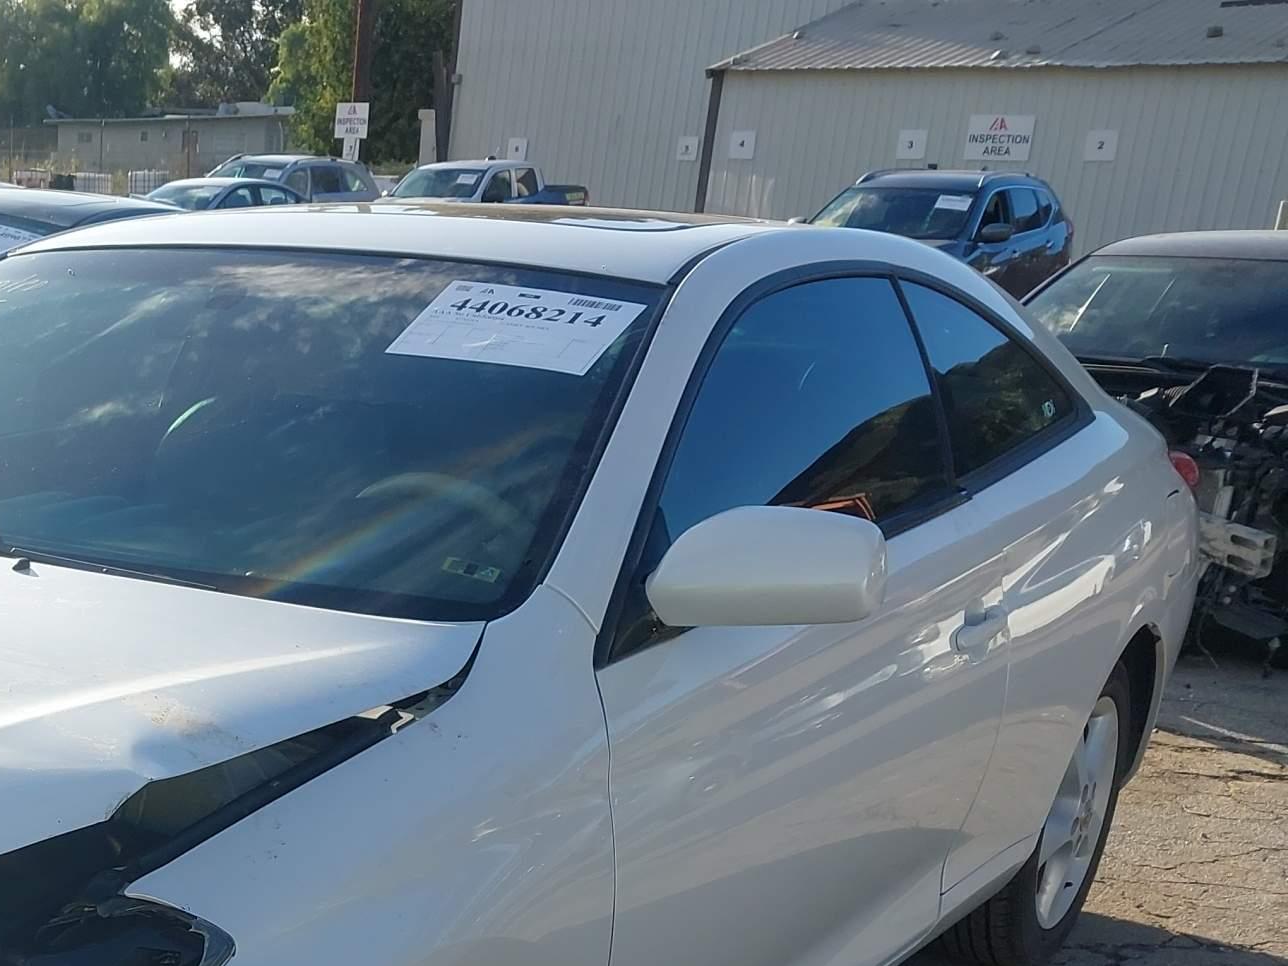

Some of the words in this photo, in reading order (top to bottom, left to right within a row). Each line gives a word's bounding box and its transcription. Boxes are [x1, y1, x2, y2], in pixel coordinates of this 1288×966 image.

[968, 133, 1031, 144] INSPECTION
[982, 145, 1010, 156] AREA
[450, 297, 607, 328] 44068214
